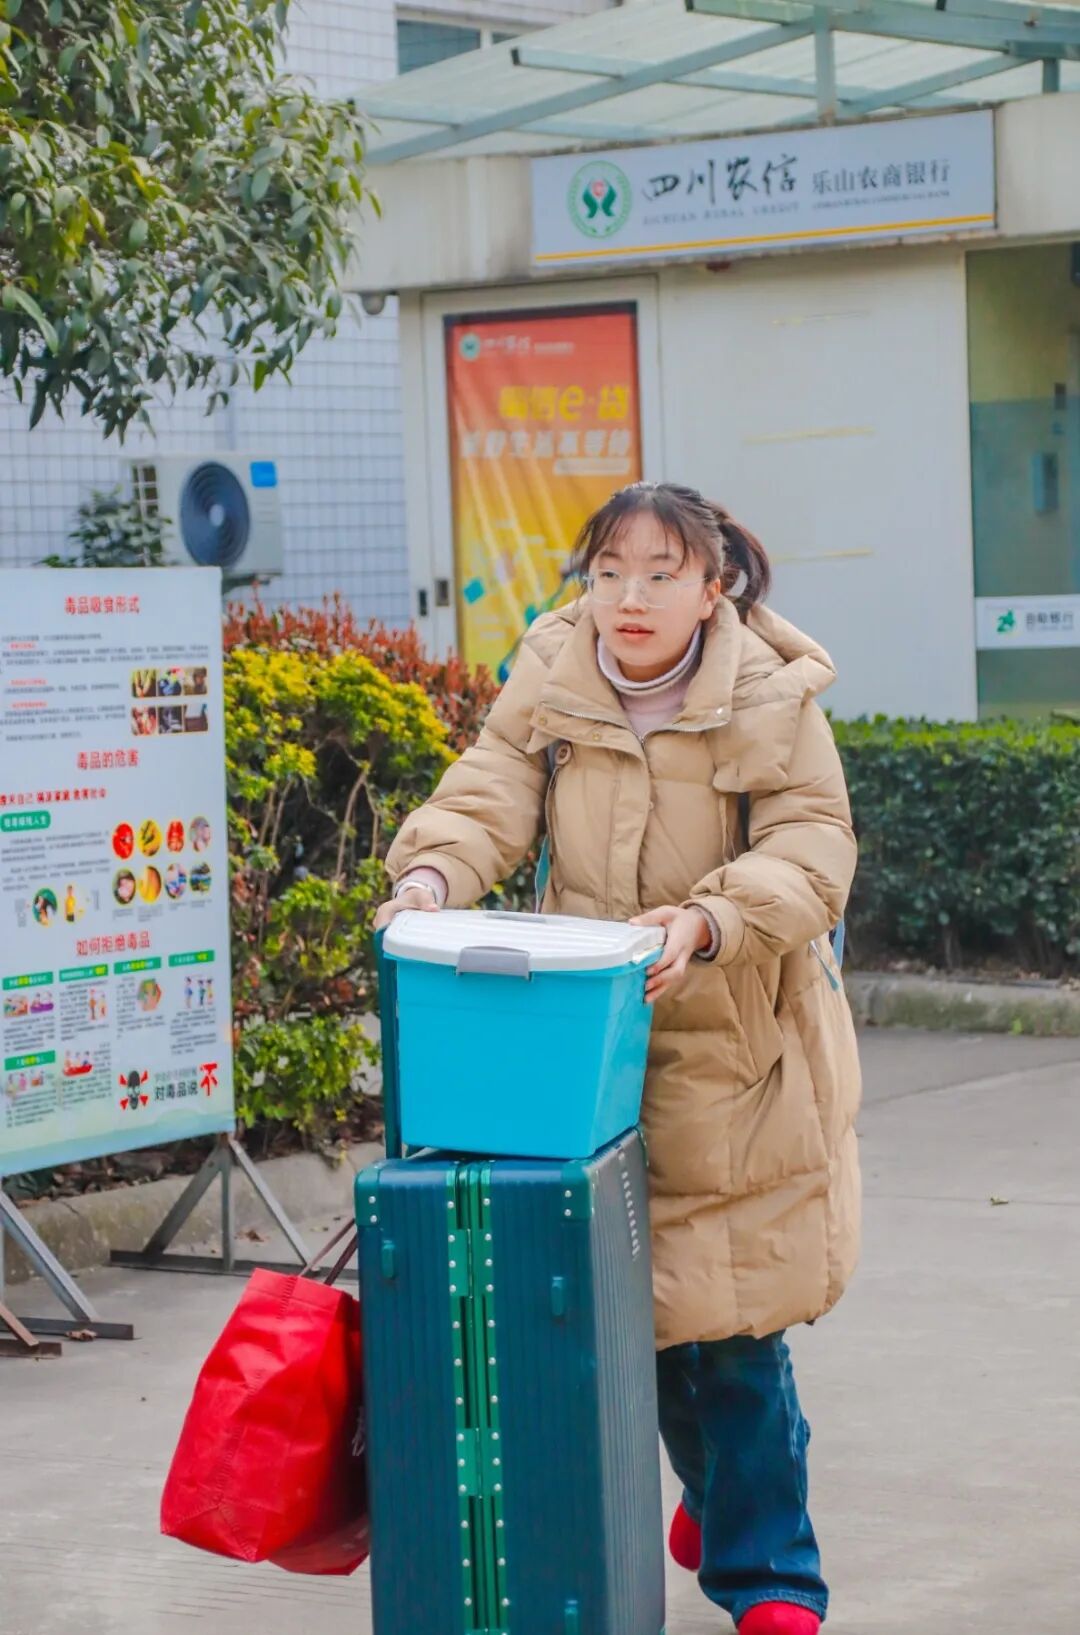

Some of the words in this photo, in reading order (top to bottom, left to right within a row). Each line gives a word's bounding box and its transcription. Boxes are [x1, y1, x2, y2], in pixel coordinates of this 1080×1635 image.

[641, 153, 797, 204] 四川农信
[812, 158, 950, 195] 乐山农商银行
[65, 595, 140, 615] 毒品吸食形式
[77, 749, 139, 770] 毒品的危害
[77, 930, 150, 956] 如何拒绝毒品
[199, 1062, 218, 1097] 不
